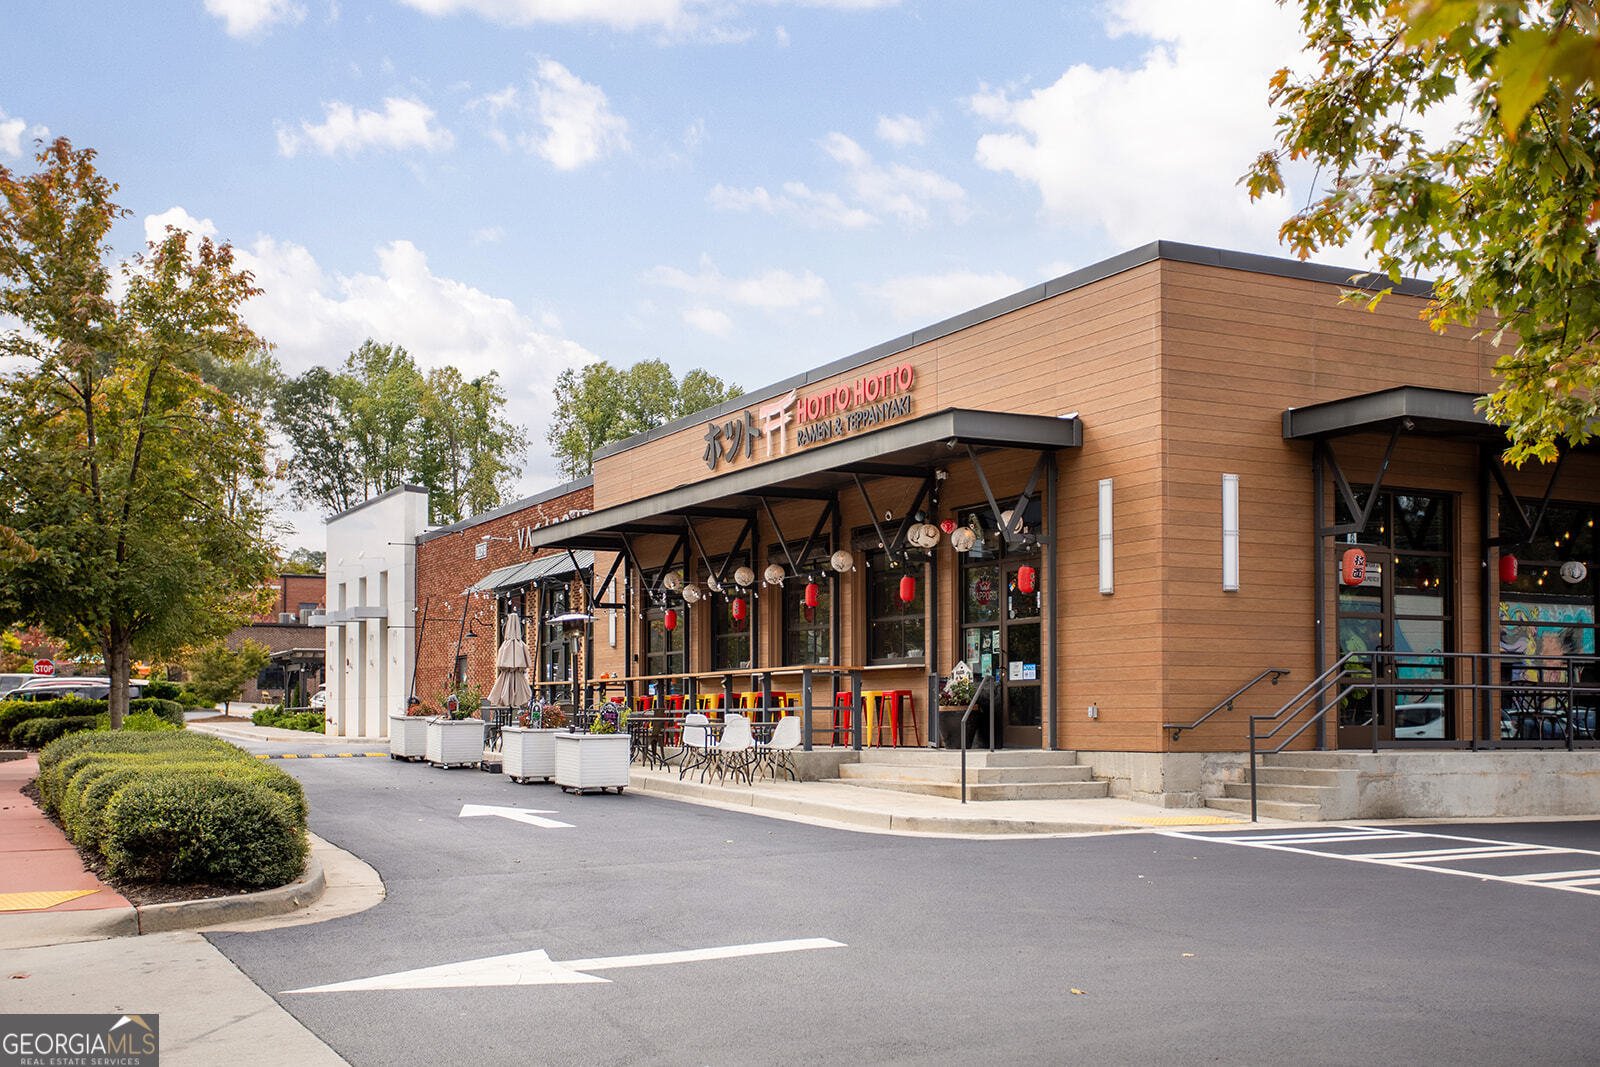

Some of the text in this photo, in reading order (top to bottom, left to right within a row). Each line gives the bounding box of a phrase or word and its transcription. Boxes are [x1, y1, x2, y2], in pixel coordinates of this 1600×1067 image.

[796, 363, 914, 424] HOTTO HOTTO
[797, 395, 911, 447] RAMEN & TEPPANYAKI
[35, 665, 52, 673] STOP
